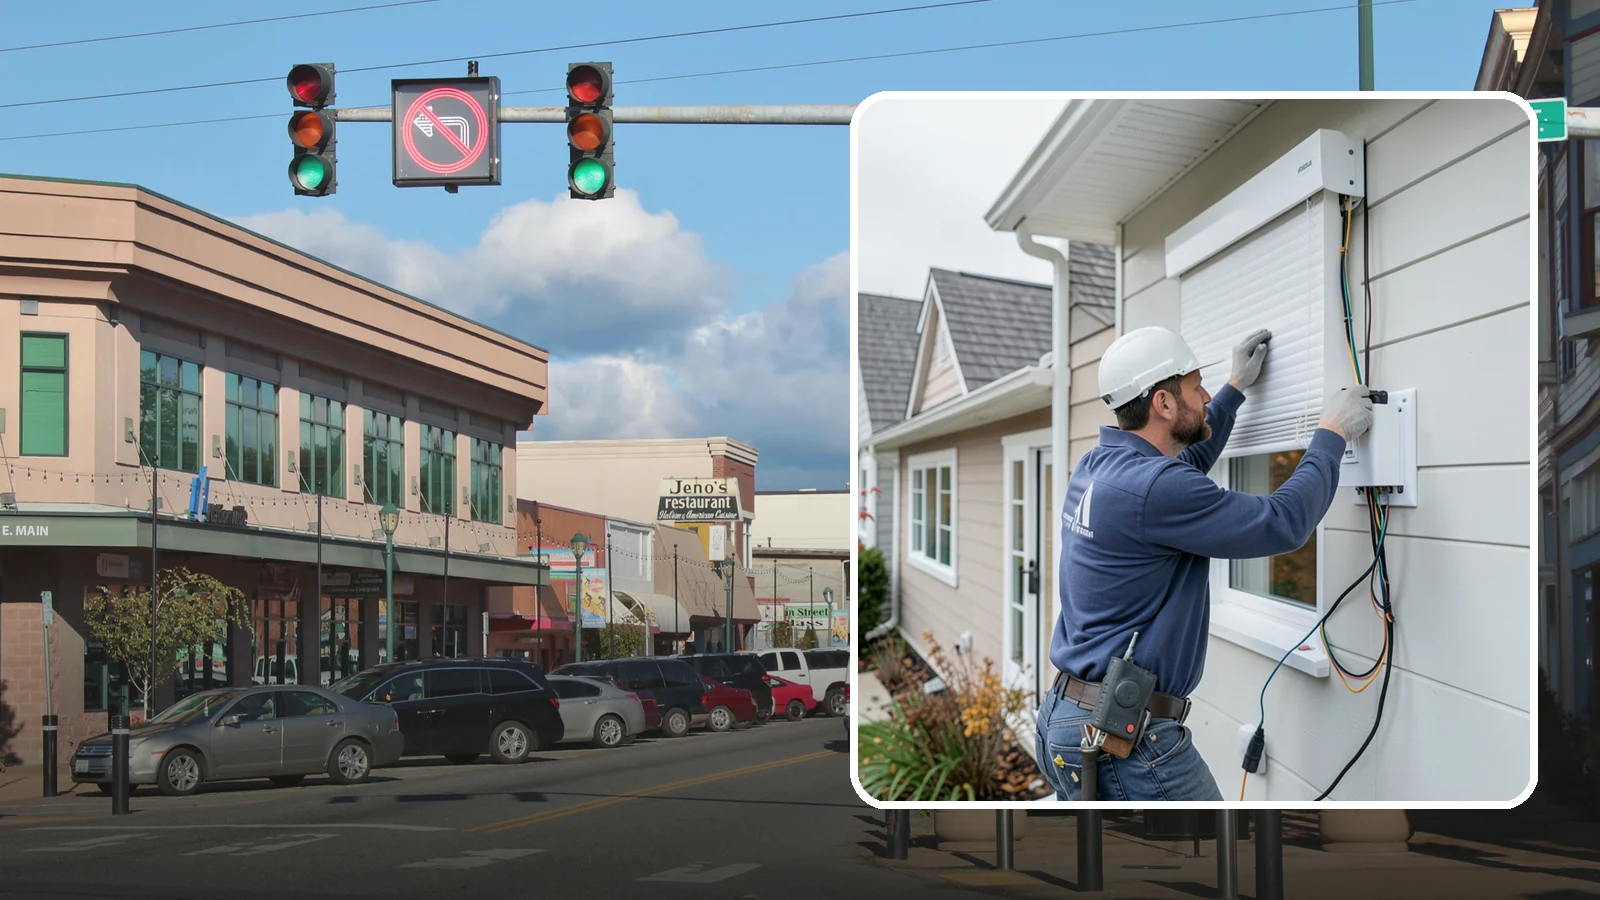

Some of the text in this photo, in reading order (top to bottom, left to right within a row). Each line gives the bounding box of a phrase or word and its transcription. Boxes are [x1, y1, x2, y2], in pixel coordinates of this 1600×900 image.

[669, 480, 728, 495] Jeno's
[664, 496, 731, 509] restaurant
[658, 510, 682, 520] Italian
[686, 510, 715, 520] American
[715, 509, 738, 520] Cuisine
[2, 525, 49, 536] E. MAIN
[797, 608, 829, 617] Street
